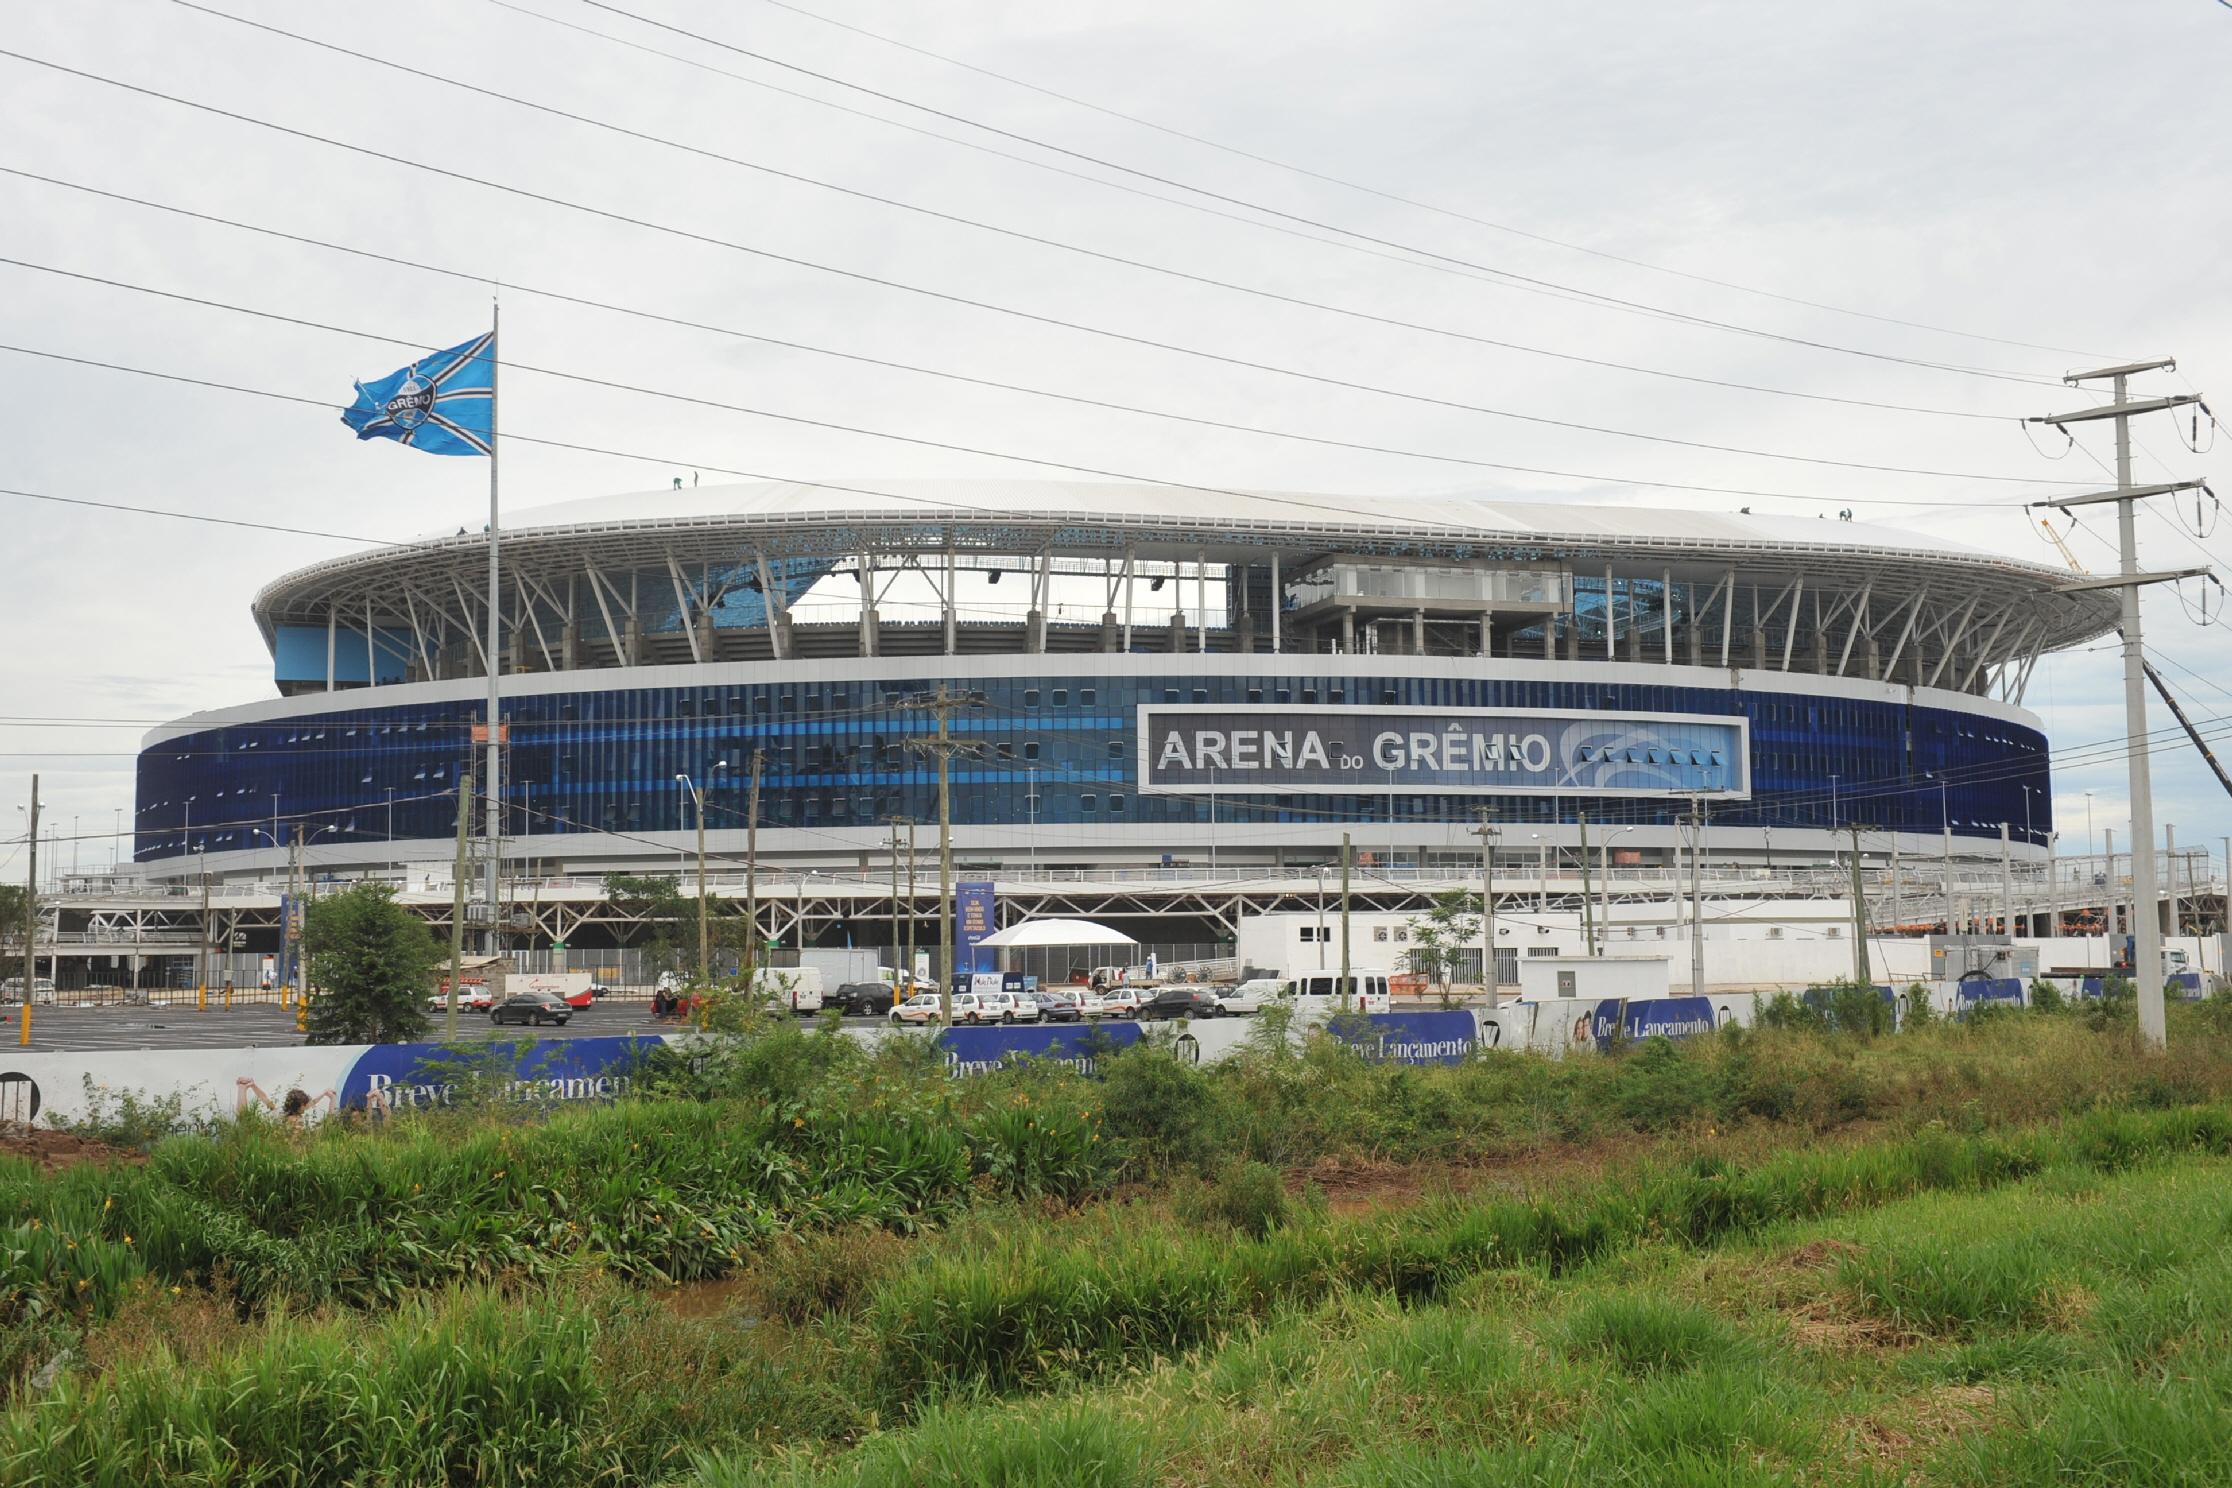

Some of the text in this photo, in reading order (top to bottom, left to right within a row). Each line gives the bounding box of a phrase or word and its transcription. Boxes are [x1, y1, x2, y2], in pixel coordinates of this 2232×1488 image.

[1157, 722, 1550, 772] ARENA DO GRÊMIO
[1598, 1016, 1630, 1038] Bree
[1379, 1033, 1472, 1064] Lançamento
